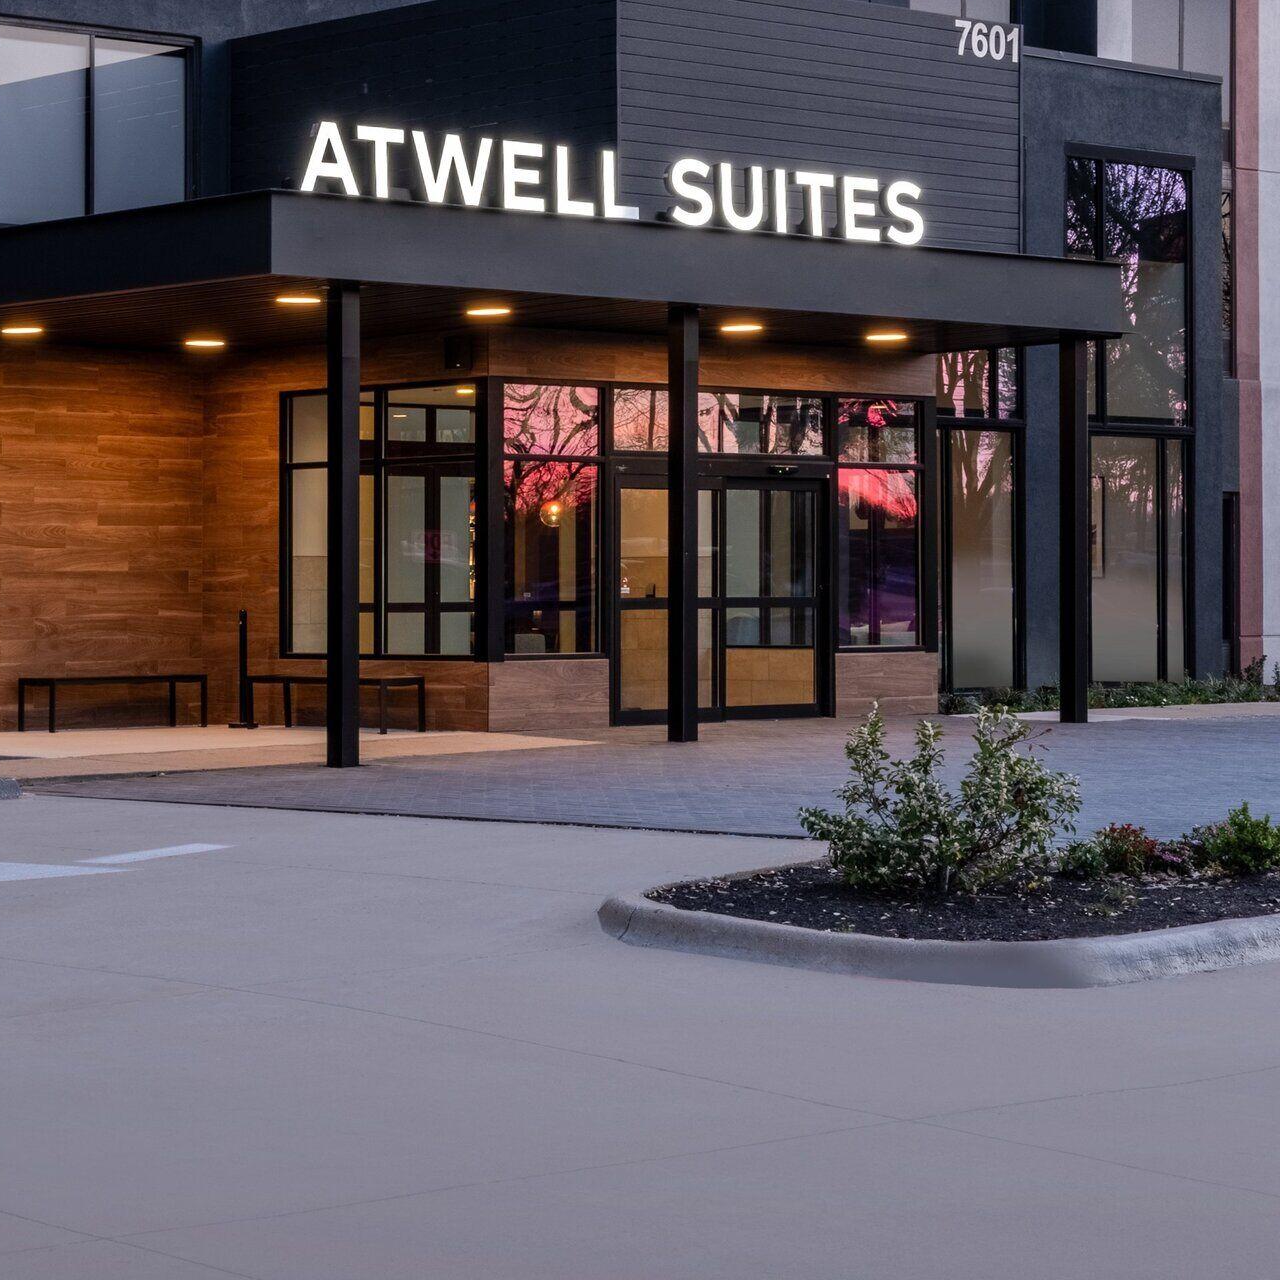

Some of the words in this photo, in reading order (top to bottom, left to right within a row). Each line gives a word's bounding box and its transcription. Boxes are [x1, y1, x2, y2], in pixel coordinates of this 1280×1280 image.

[954, 19, 1019, 63] 7601
[300, 120, 640, 220] ATWELL
[670, 156, 926, 247] SUITES
